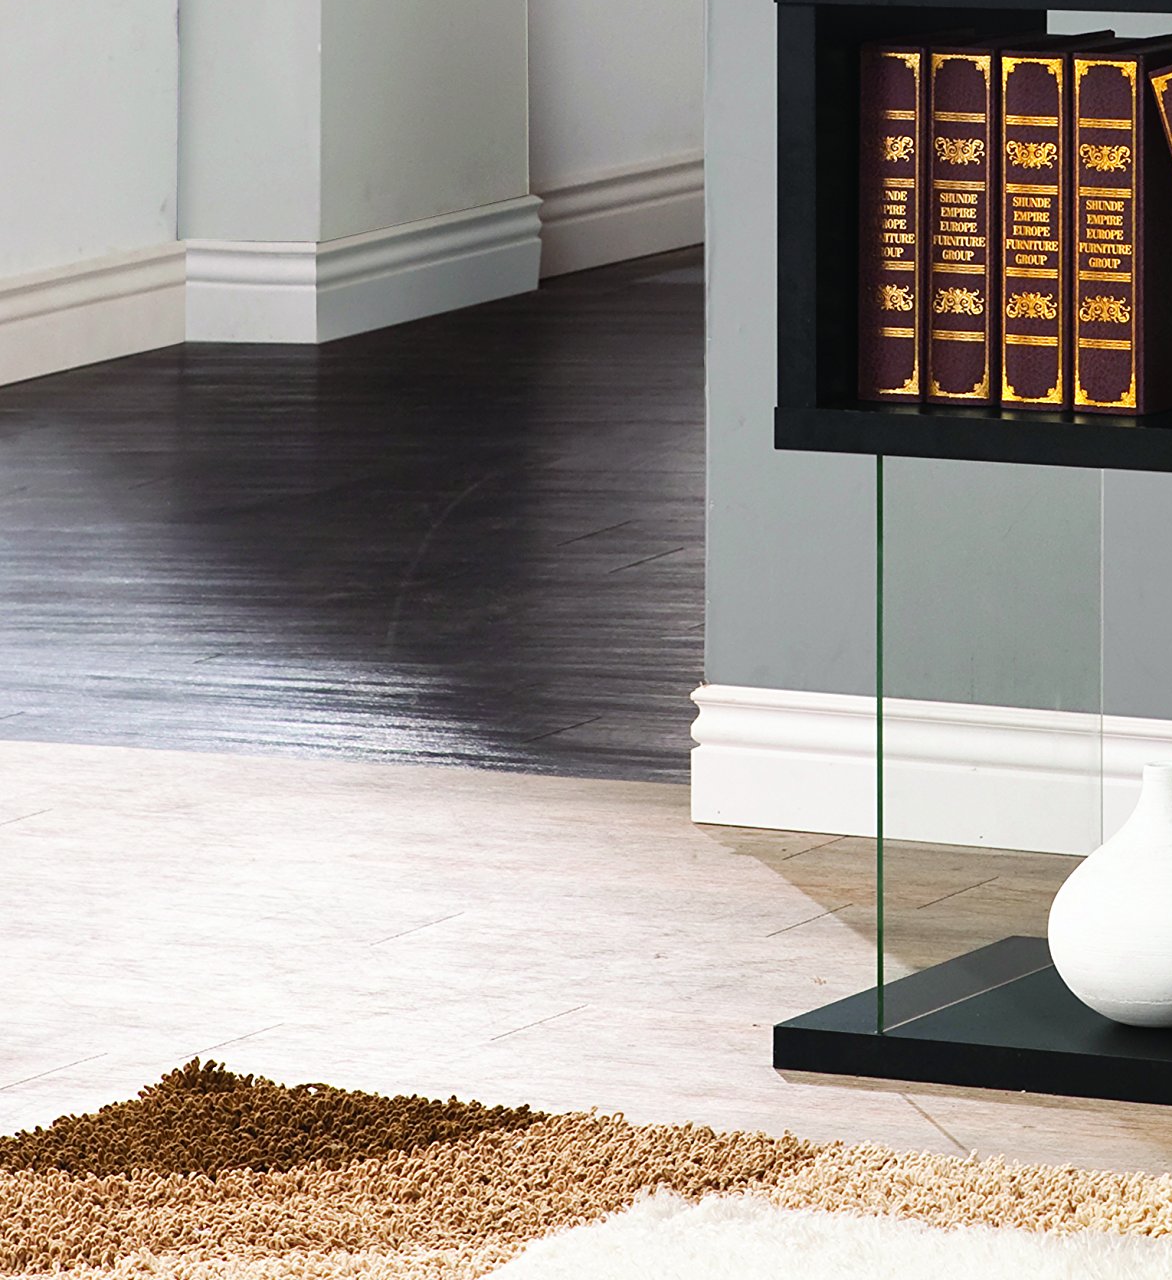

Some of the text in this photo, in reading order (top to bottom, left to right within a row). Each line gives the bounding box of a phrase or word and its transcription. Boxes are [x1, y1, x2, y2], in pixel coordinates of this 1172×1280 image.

[939, 192, 978, 205] SHUNDE
[1012, 196, 1051, 208] SHUNDE
[940, 206, 977, 219] EMPIRE
[1085, 200, 1125, 213] SHUNDE
[1013, 210, 1050, 223] EMPIRE
[1086, 214, 1123, 227] EMPIRE
[939, 220, 978, 233] EUROPE
[1012, 224, 1051, 237] EUROPE
[1086, 228, 1124, 241] EUROPE
[933, 235, 986, 248] FURNITURE
[1005, 238, 1059, 252] FURNITURE
[1079, 242, 1132, 255] FURNITURE
[942, 249, 975, 262] GROUP
[1015, 254, 1048, 266] GROUP
[1088, 257, 1121, 269] GROUP
